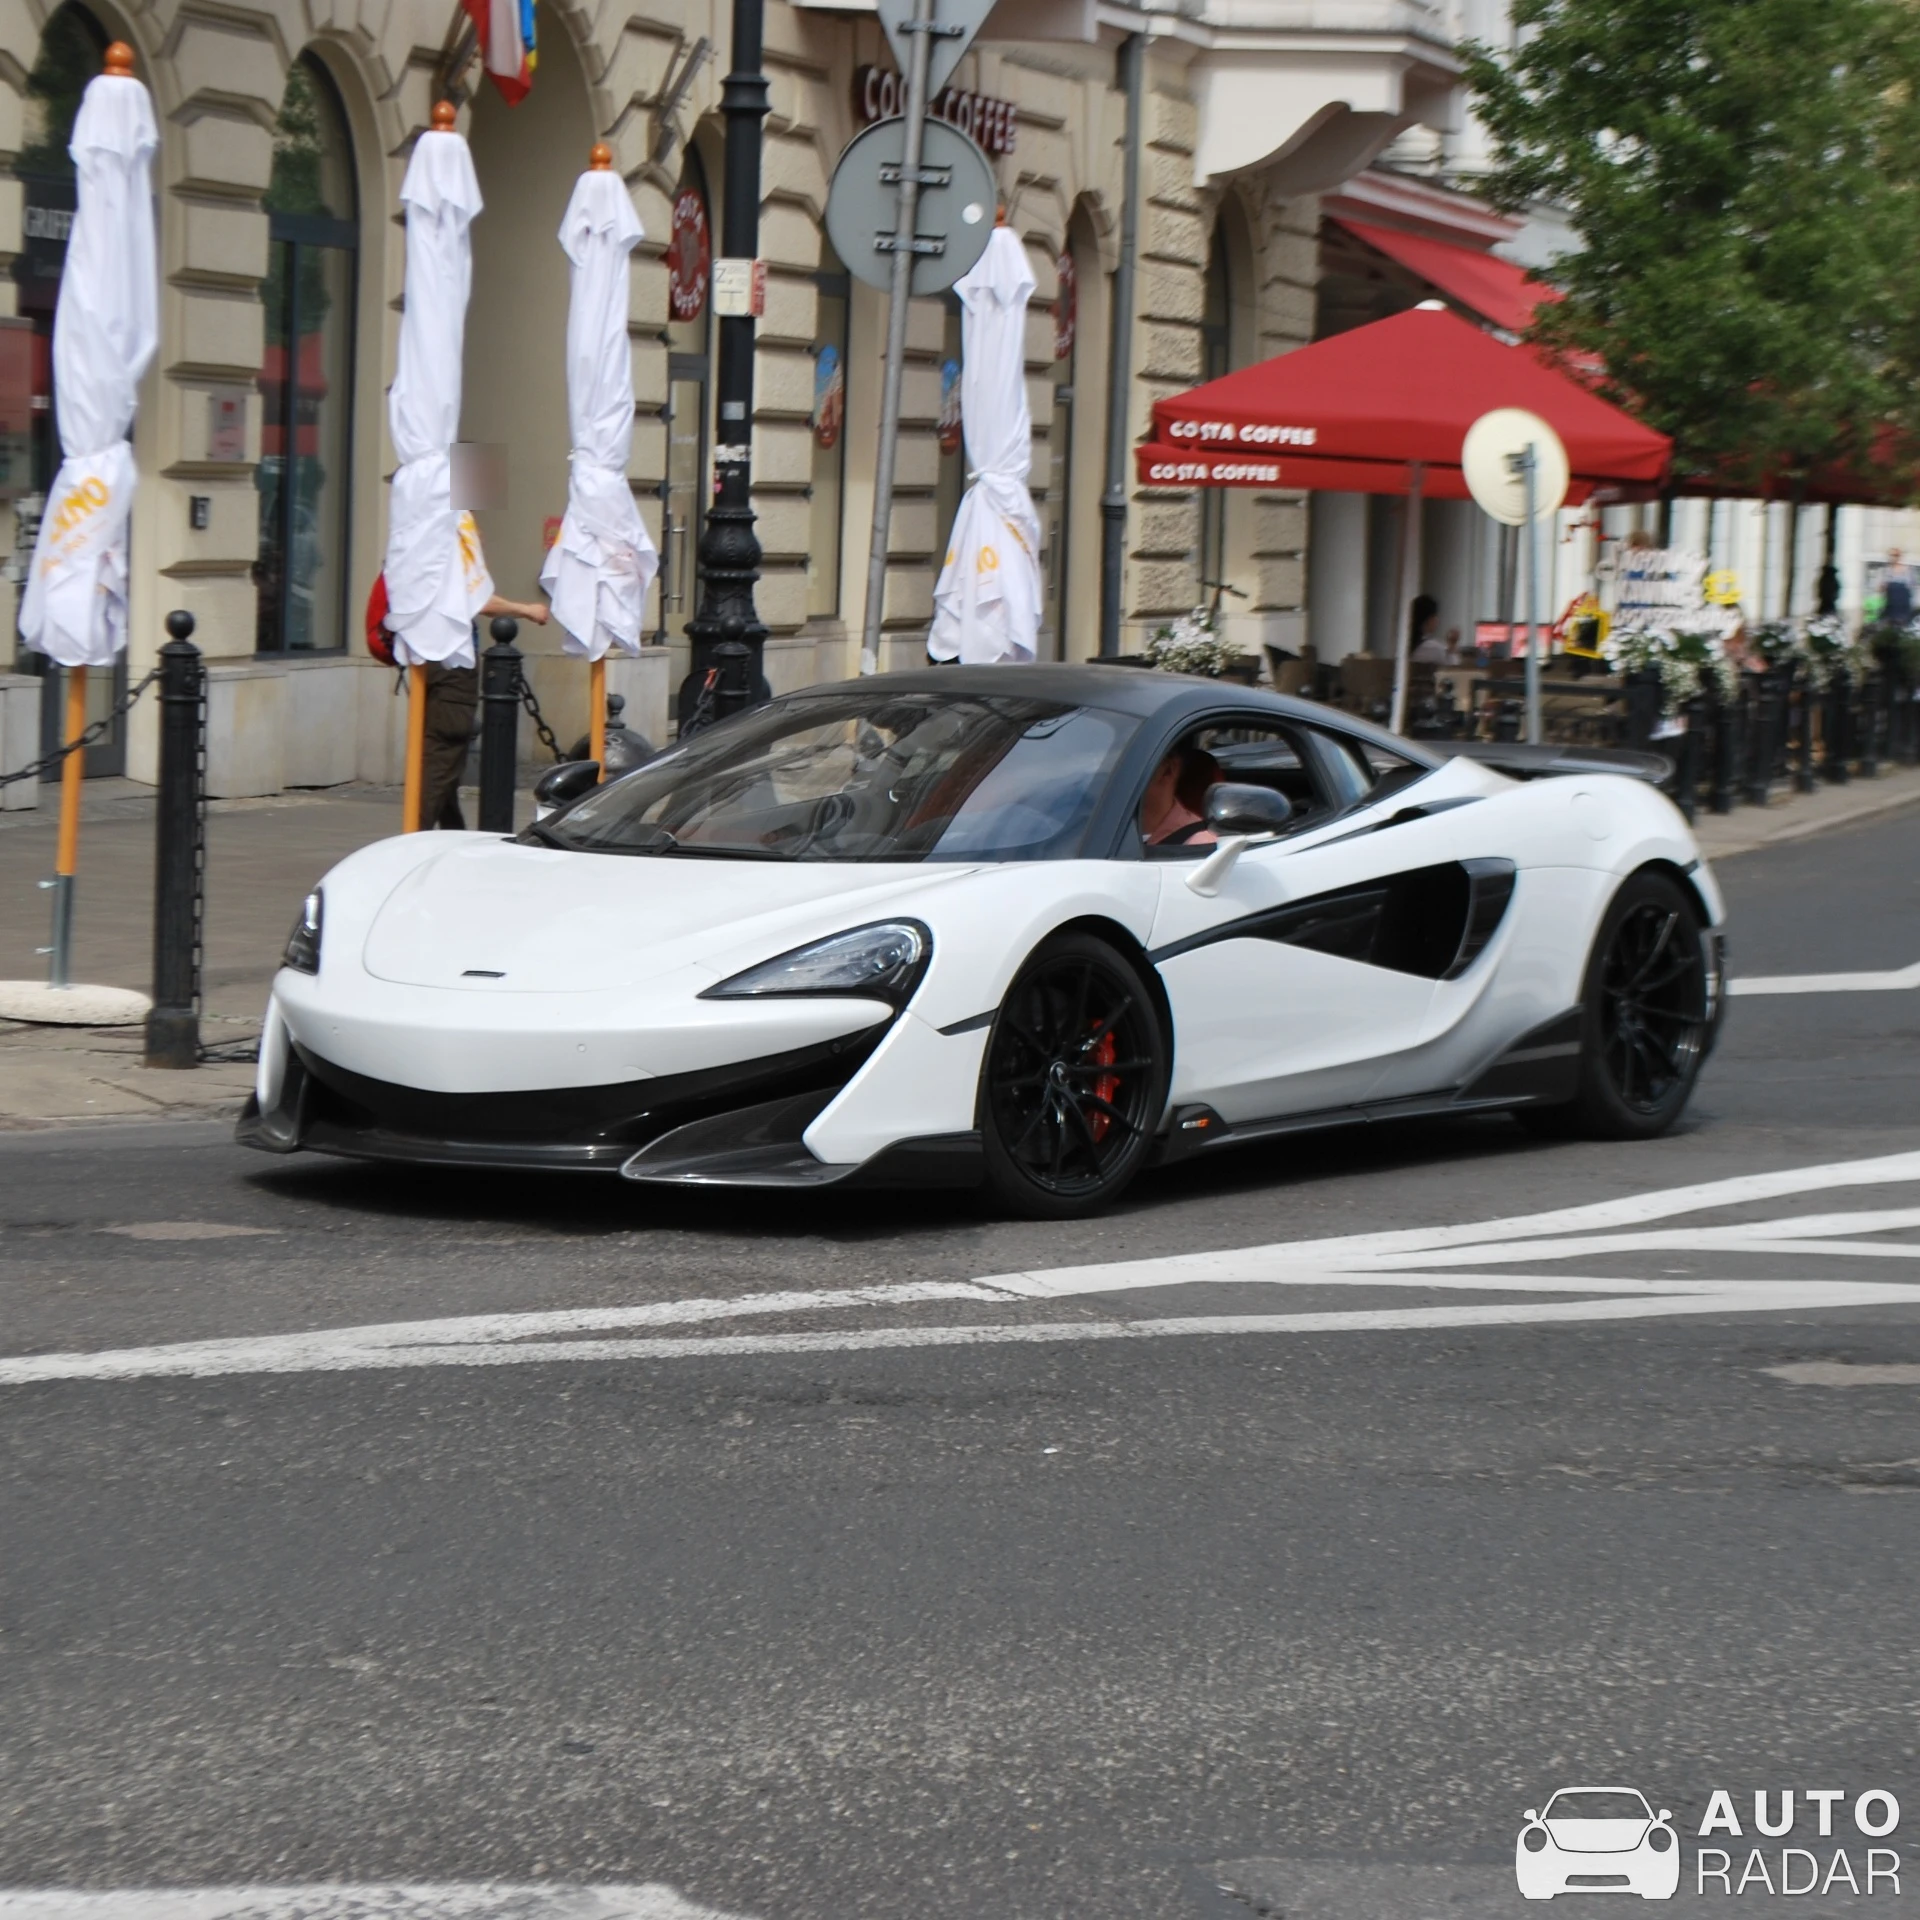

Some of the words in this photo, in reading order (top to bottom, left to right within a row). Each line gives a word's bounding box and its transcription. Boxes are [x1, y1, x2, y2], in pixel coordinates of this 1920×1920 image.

[1169, 420, 1235, 441] COSTA
[1239, 424, 1317, 446] COFFEE
[1150, 463, 1208, 481] COSTA
[1211, 464, 1280, 482] COFFEE
